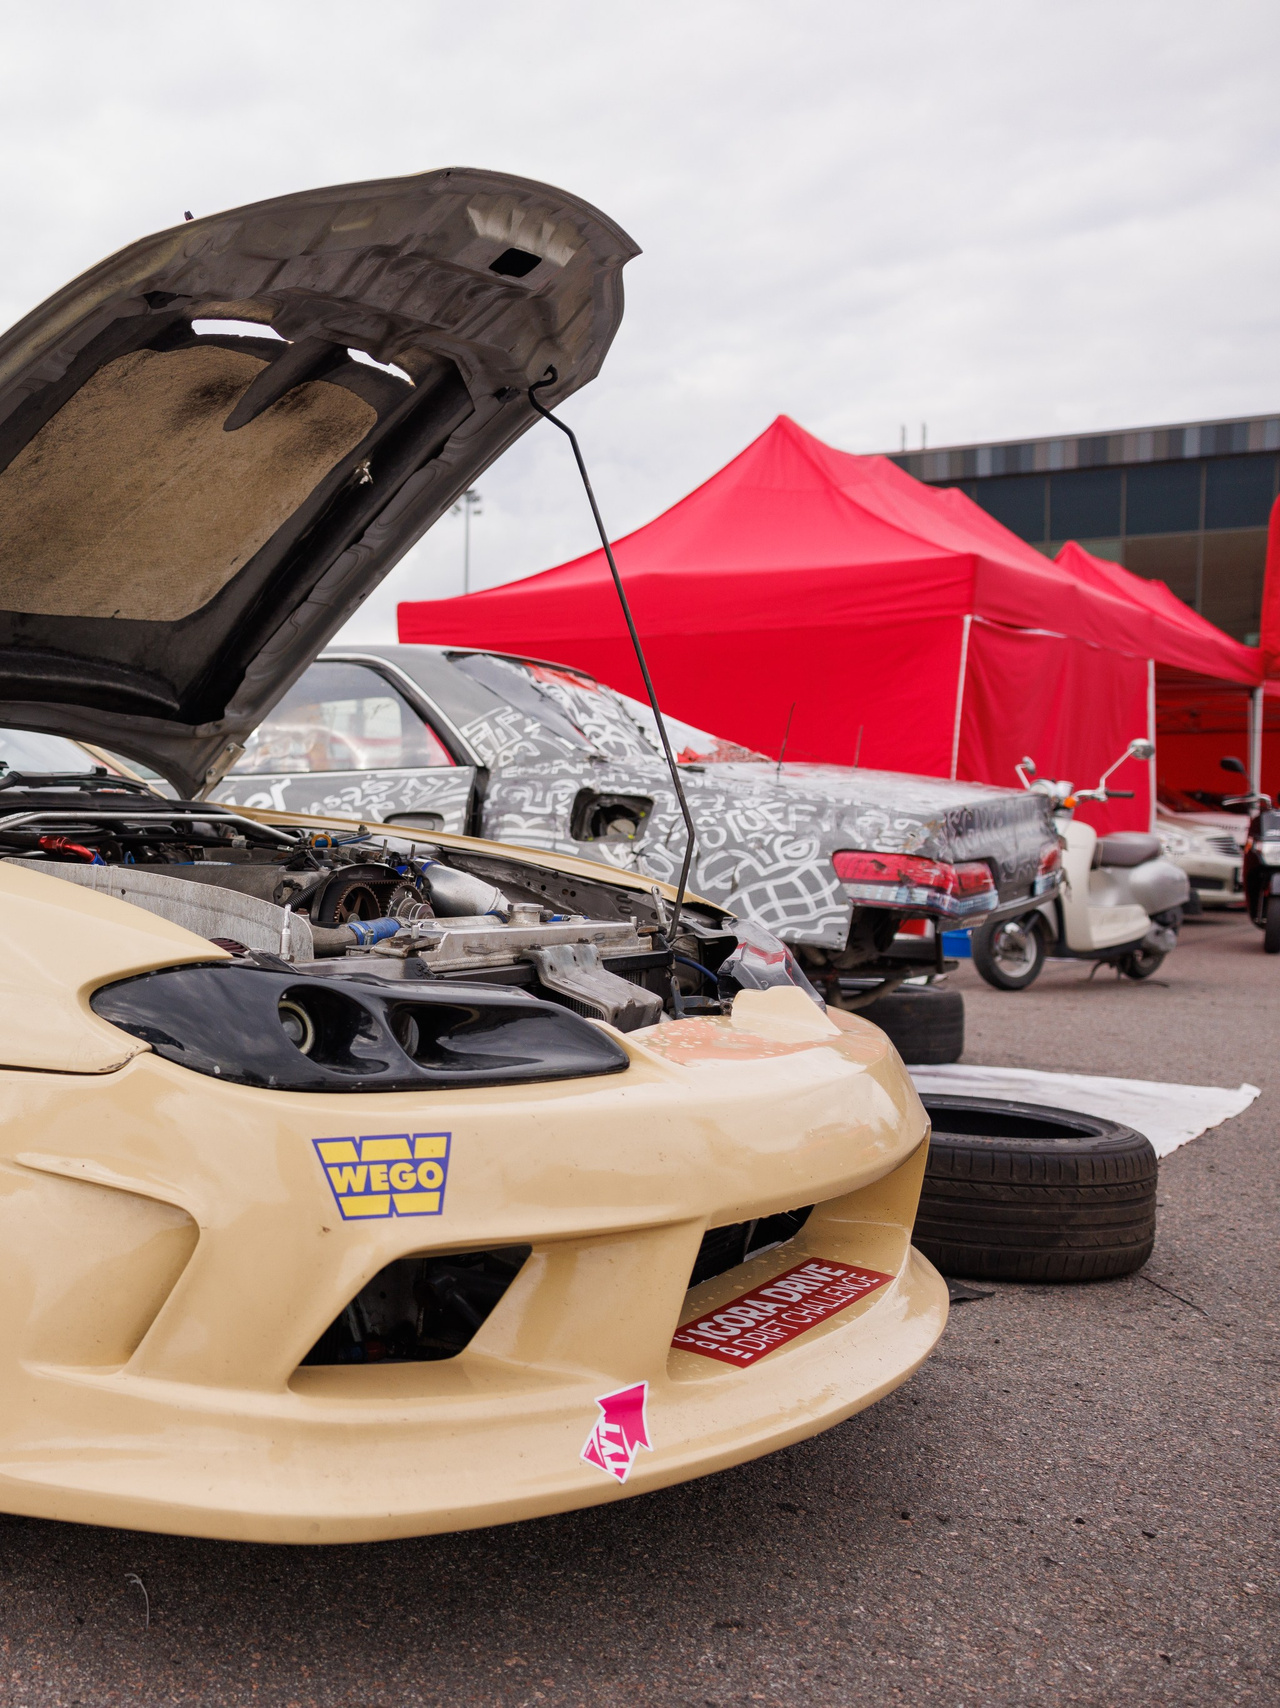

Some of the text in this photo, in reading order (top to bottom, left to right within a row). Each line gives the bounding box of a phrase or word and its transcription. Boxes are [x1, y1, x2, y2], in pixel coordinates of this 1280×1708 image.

[326, 1160, 445, 1194] WEGO
[685, 1263, 848, 1342] IGORA DRIVE
[731, 1272, 881, 1351] DRIFT CHALLENGE
